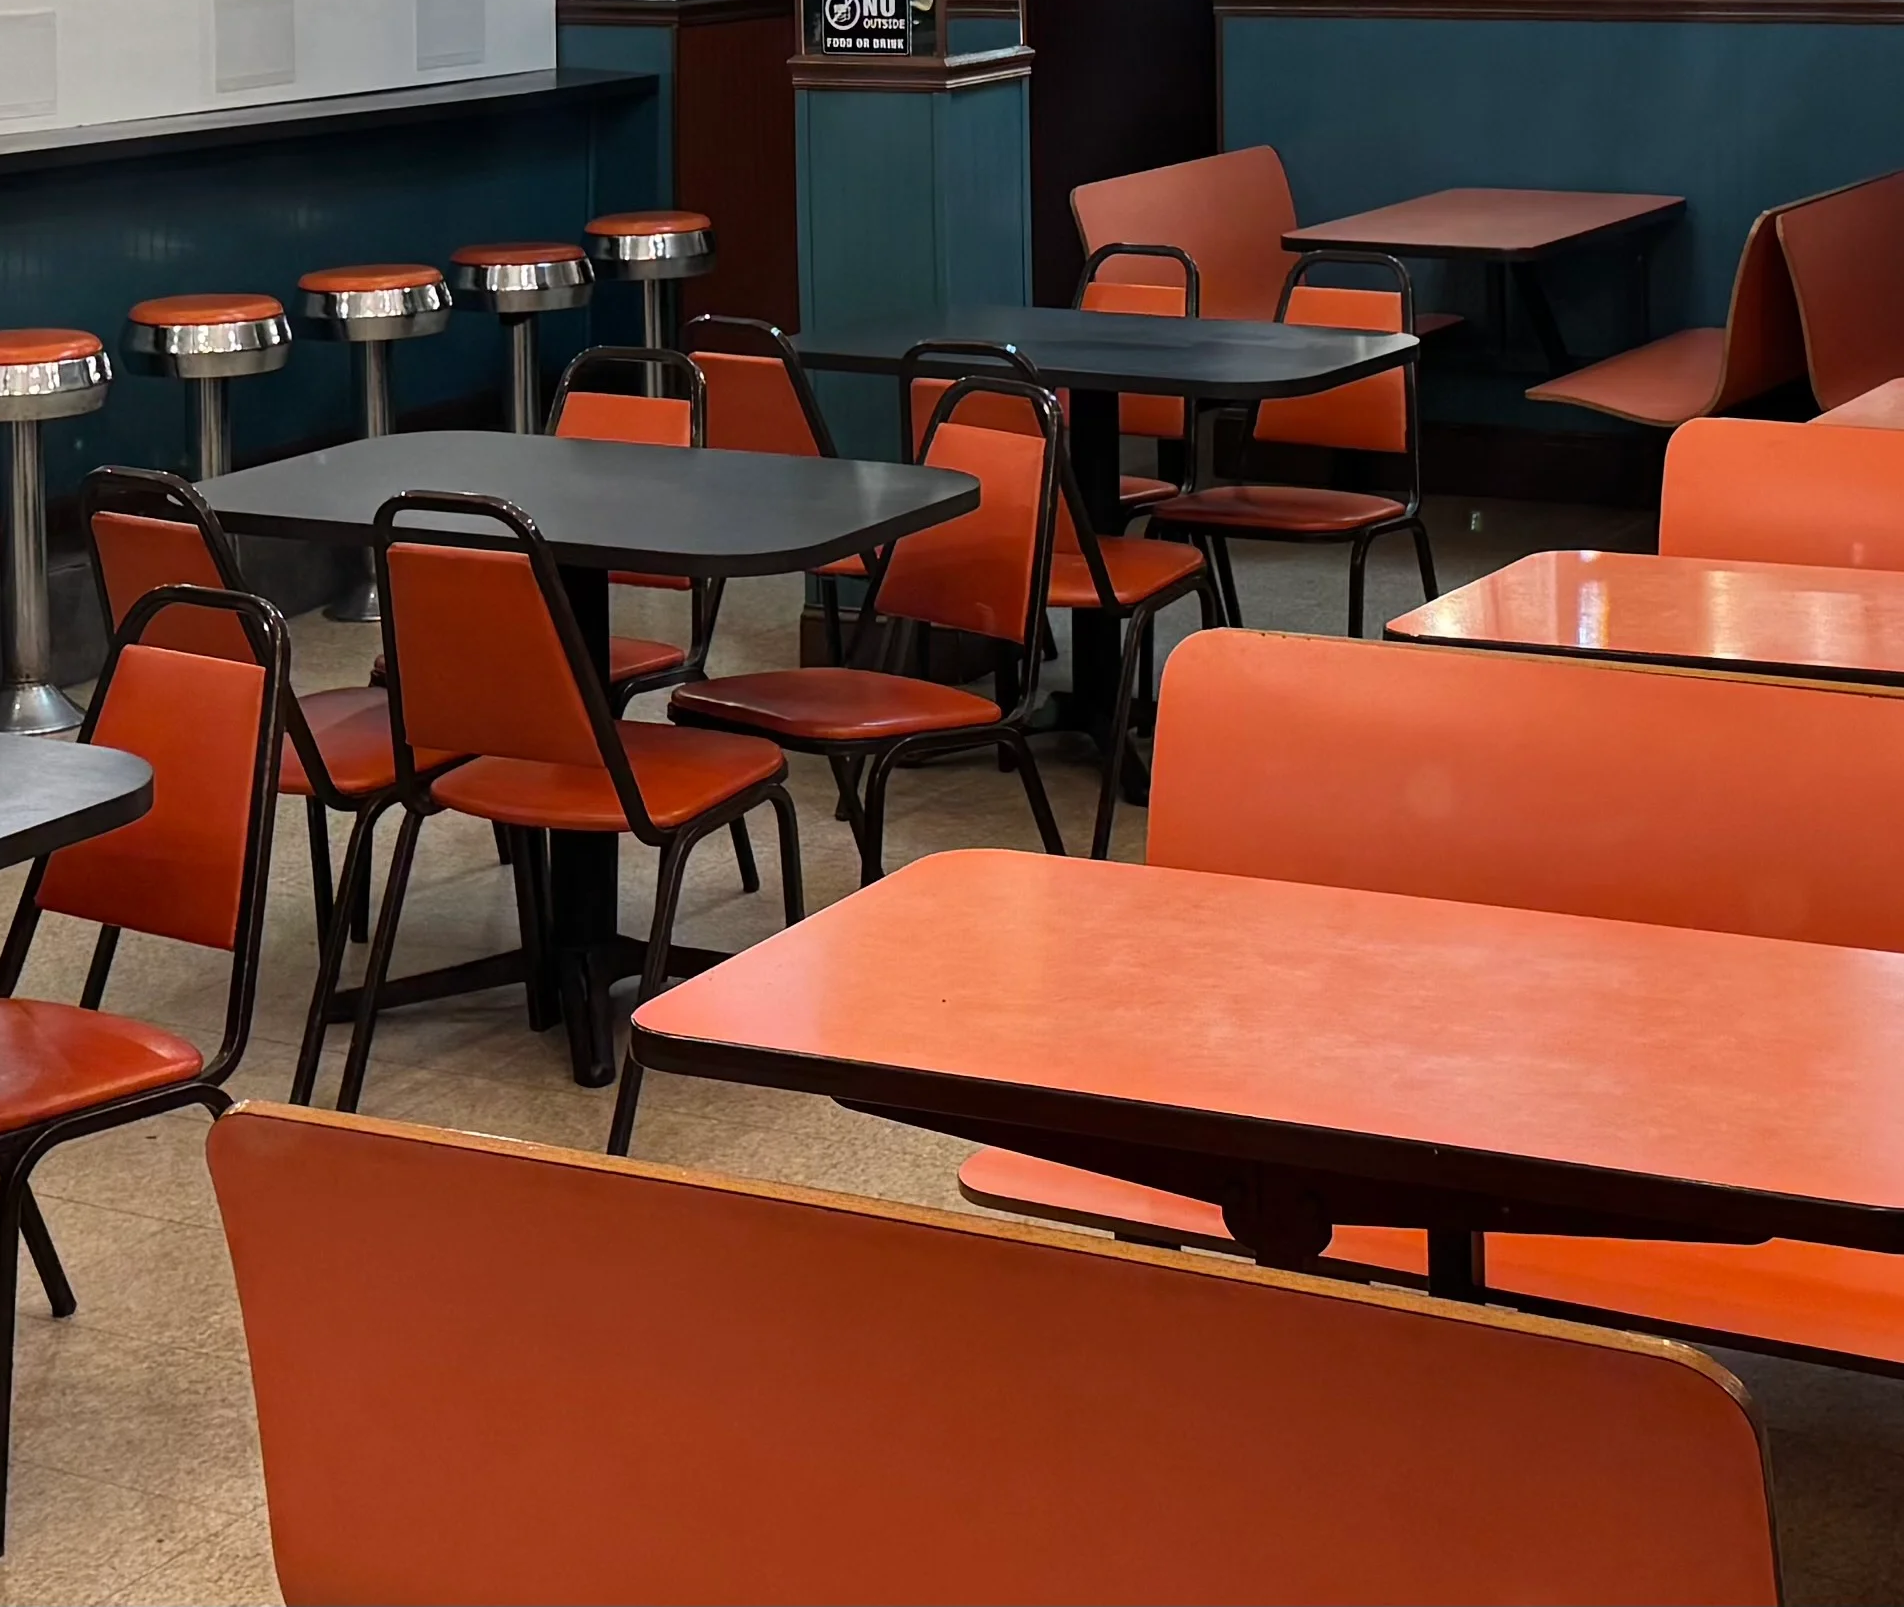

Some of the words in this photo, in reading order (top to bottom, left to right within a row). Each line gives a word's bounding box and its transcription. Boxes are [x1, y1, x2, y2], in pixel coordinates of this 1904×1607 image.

[863, 18, 905, 30] OUTSIDE
[826, 37, 852, 48] FOOD
[856, 38, 869, 48] OR
[873, 38, 904, 49] DRINK
